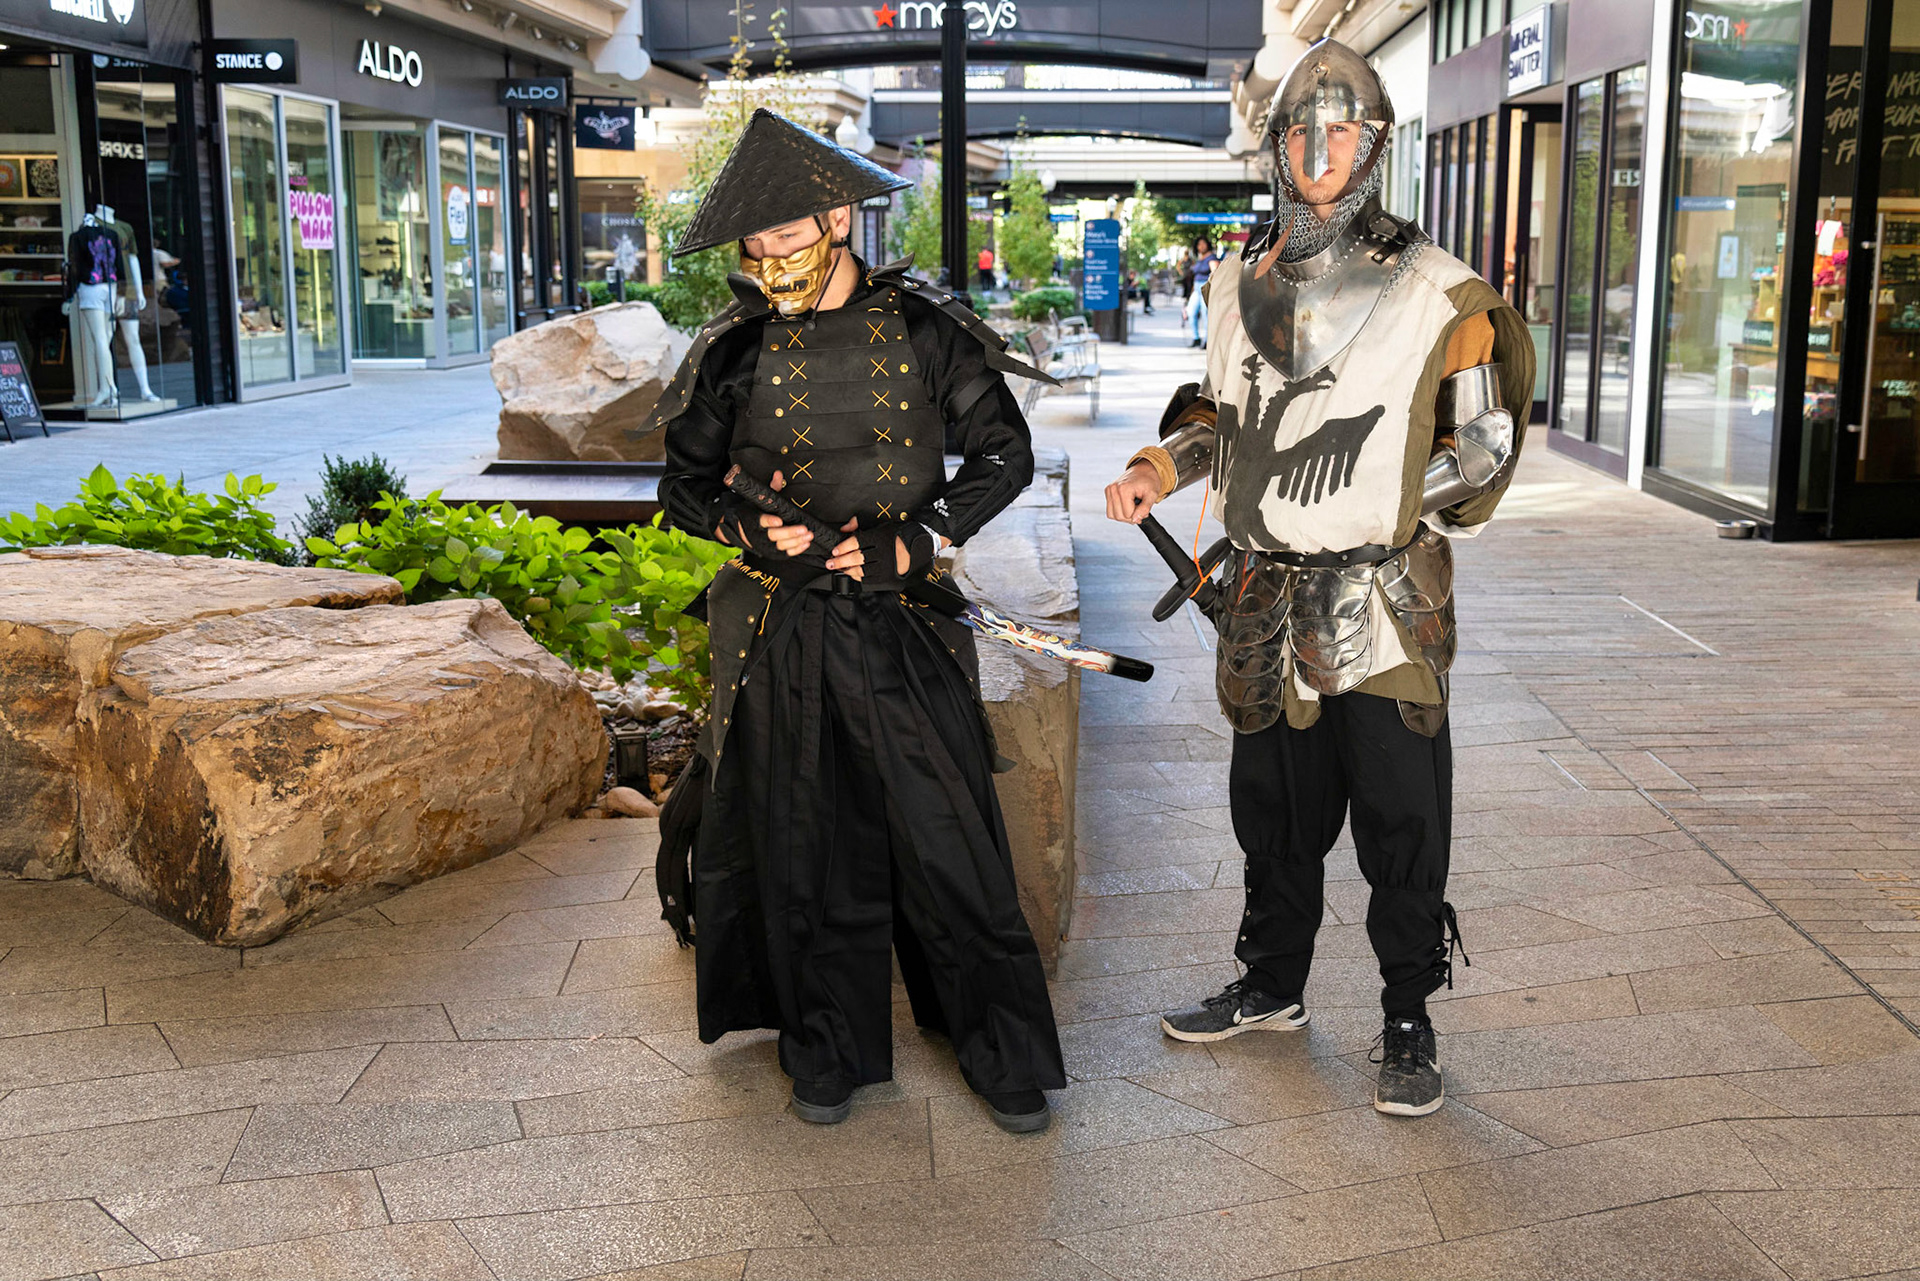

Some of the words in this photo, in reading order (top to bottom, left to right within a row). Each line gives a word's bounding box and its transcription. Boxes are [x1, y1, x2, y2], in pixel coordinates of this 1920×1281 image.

[215, 53, 263, 69] STANCE
[358, 39, 423, 88] ALDO
[505, 86, 559, 100] ALDO
[289, 192, 334, 218] PILLOW
[300, 218, 333, 242] WALK
